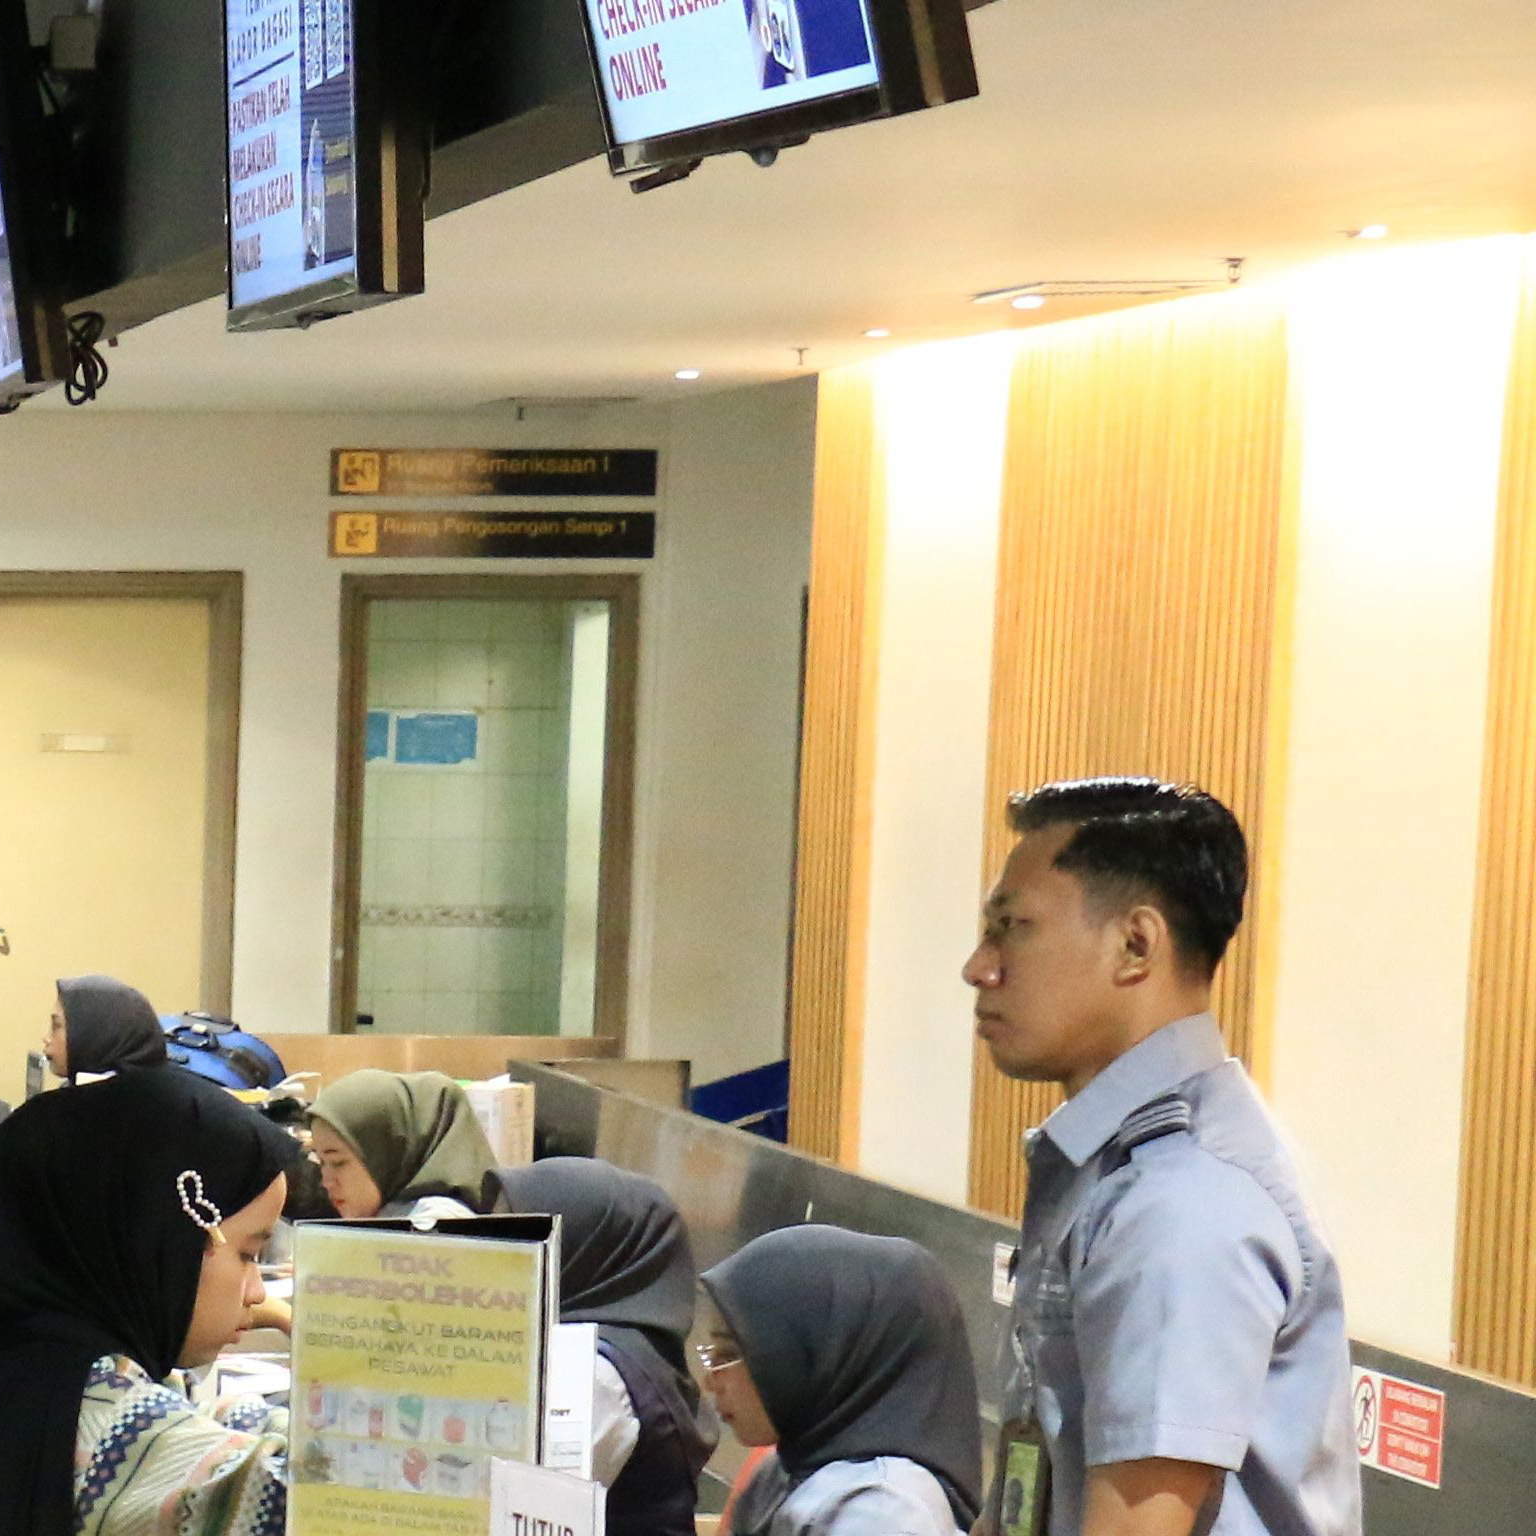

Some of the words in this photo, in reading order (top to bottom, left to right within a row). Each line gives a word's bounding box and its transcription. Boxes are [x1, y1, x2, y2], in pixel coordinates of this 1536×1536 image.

[609, 43, 667, 101] ONLINE
[379, 1251, 453, 1278] TIDAK
[440, 1323, 525, 1345] BARANG
[305, 1332, 419, 1356] BERBAHAYA
[454, 1345, 523, 1365] DALAM
[368, 1357, 455, 1378] PESAWAT
